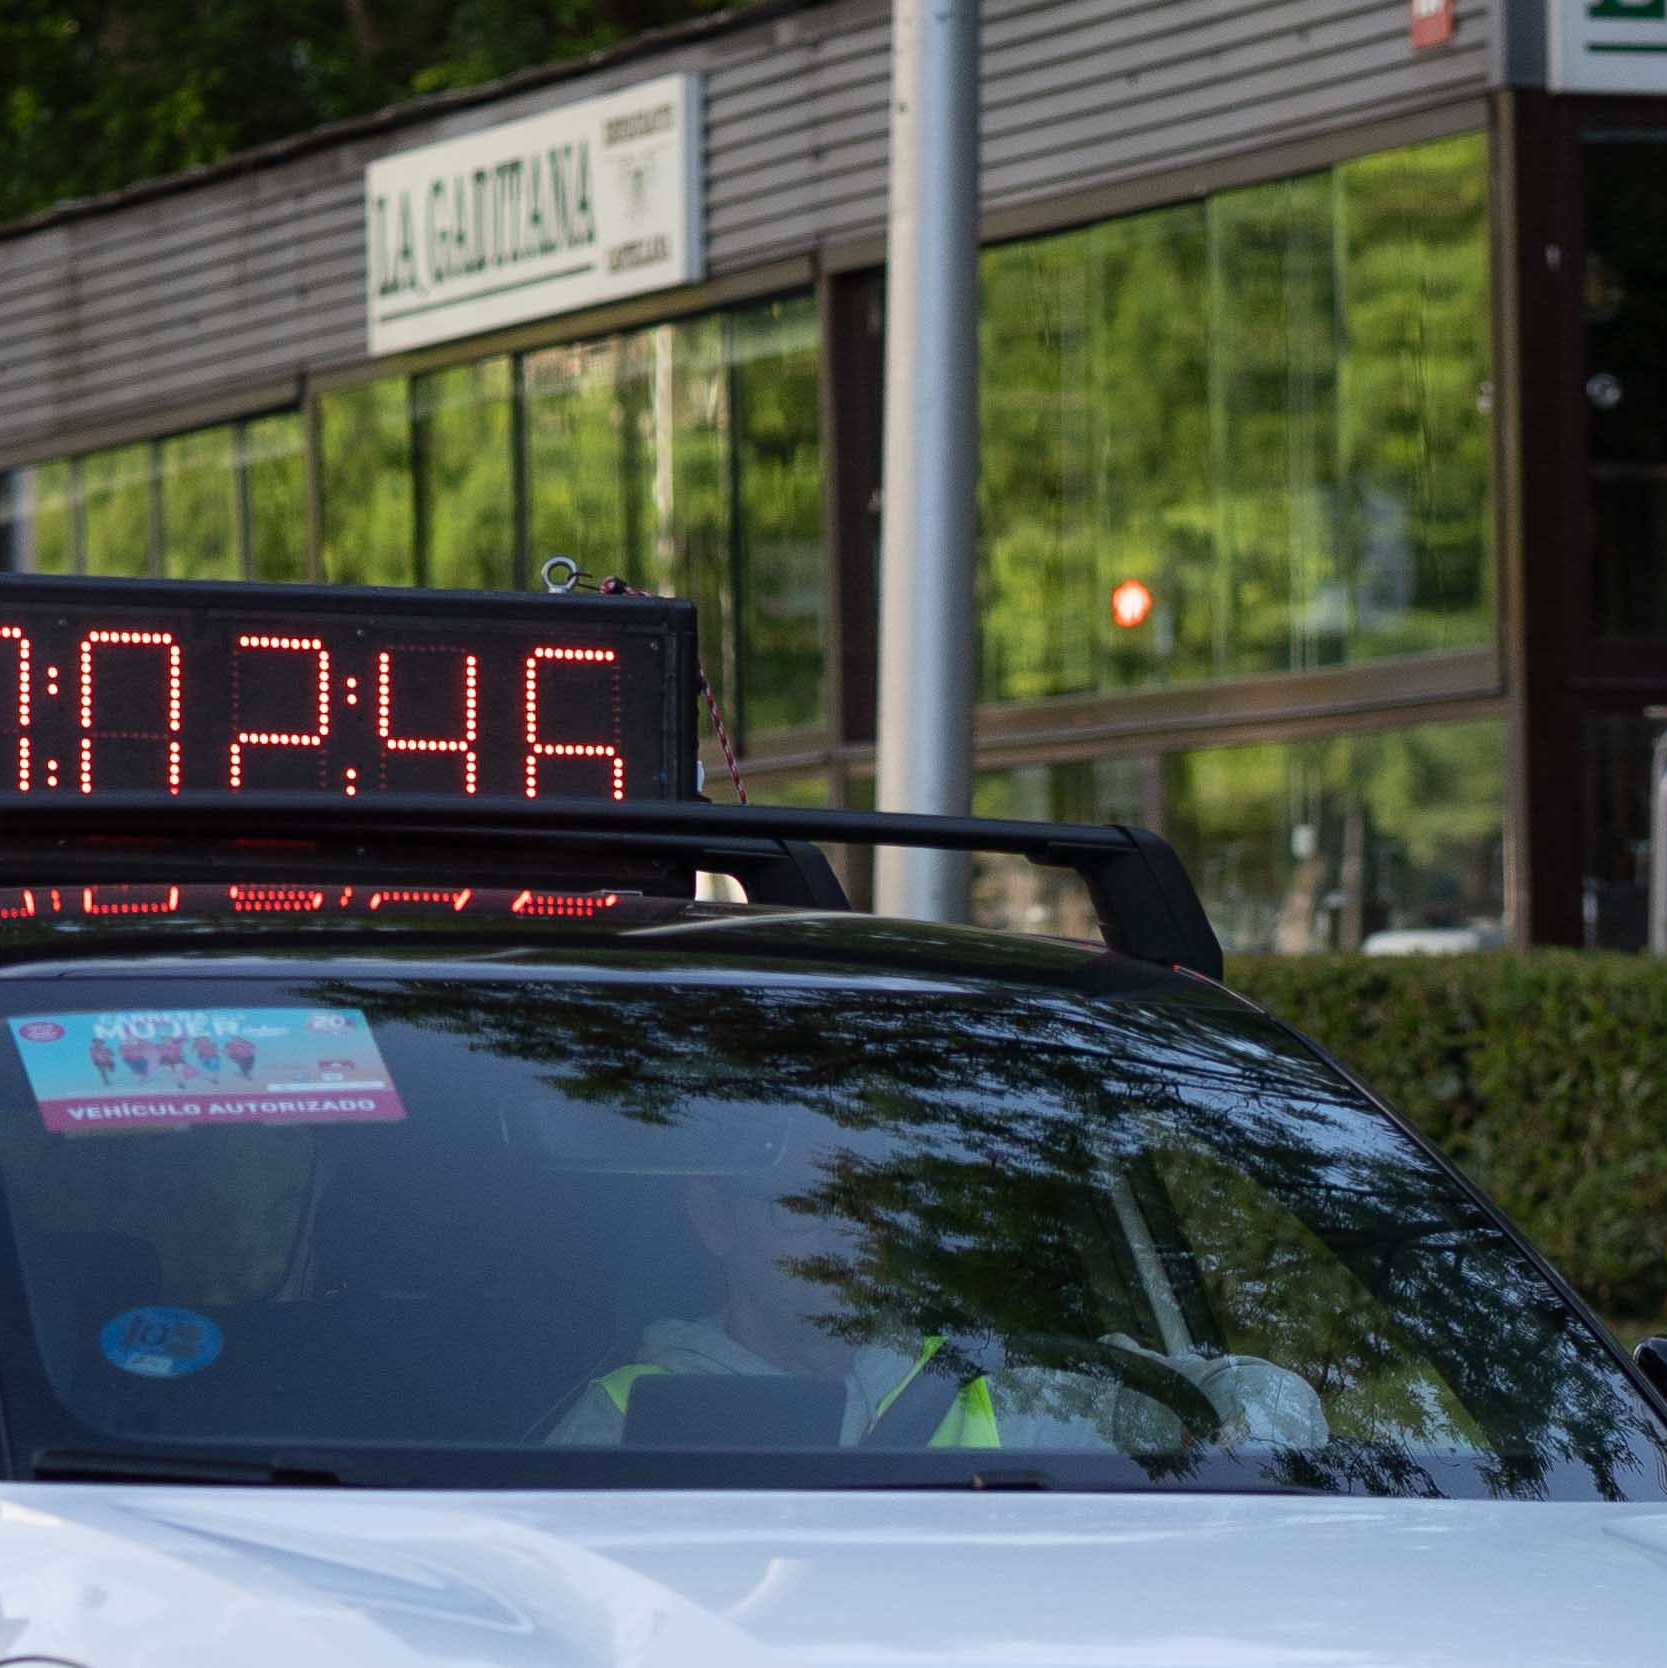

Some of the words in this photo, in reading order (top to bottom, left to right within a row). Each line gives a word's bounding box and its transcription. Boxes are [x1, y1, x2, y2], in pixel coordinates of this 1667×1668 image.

[376, 190, 424, 296] LA
[93, 1020, 239, 1039] MUJER
[67, 1101, 201, 1121] VEHÍCULO
[208, 1098, 376, 1116] AUTORIZADO
